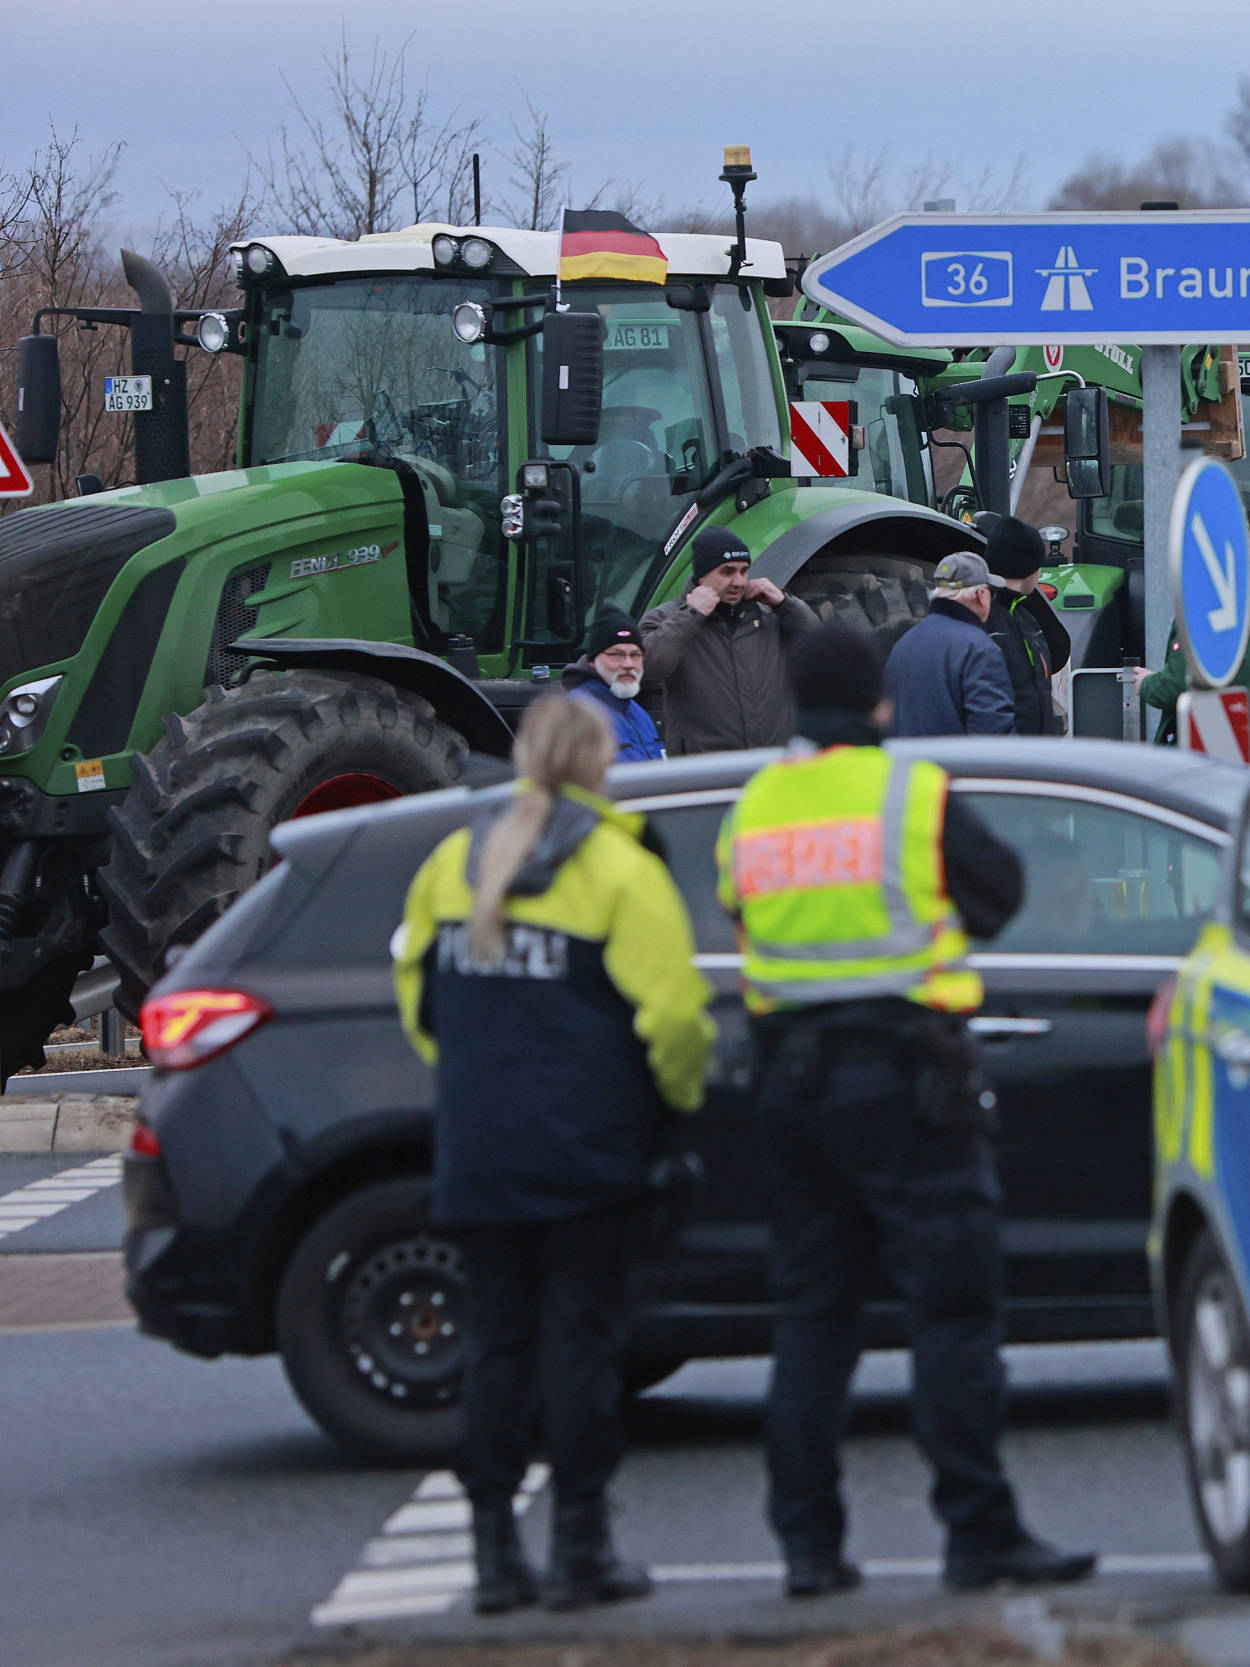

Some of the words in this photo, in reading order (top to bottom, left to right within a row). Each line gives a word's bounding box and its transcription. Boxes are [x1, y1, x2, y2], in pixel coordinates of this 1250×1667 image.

[947, 262, 988, 295] 36
[614, 328, 636, 347] AG
[640, 328, 662, 346] 81
[113, 379, 128, 393] HZ
[109, 394, 123, 410] AG
[126, 395, 148, 409] 939
[347, 544, 380, 563] 939
